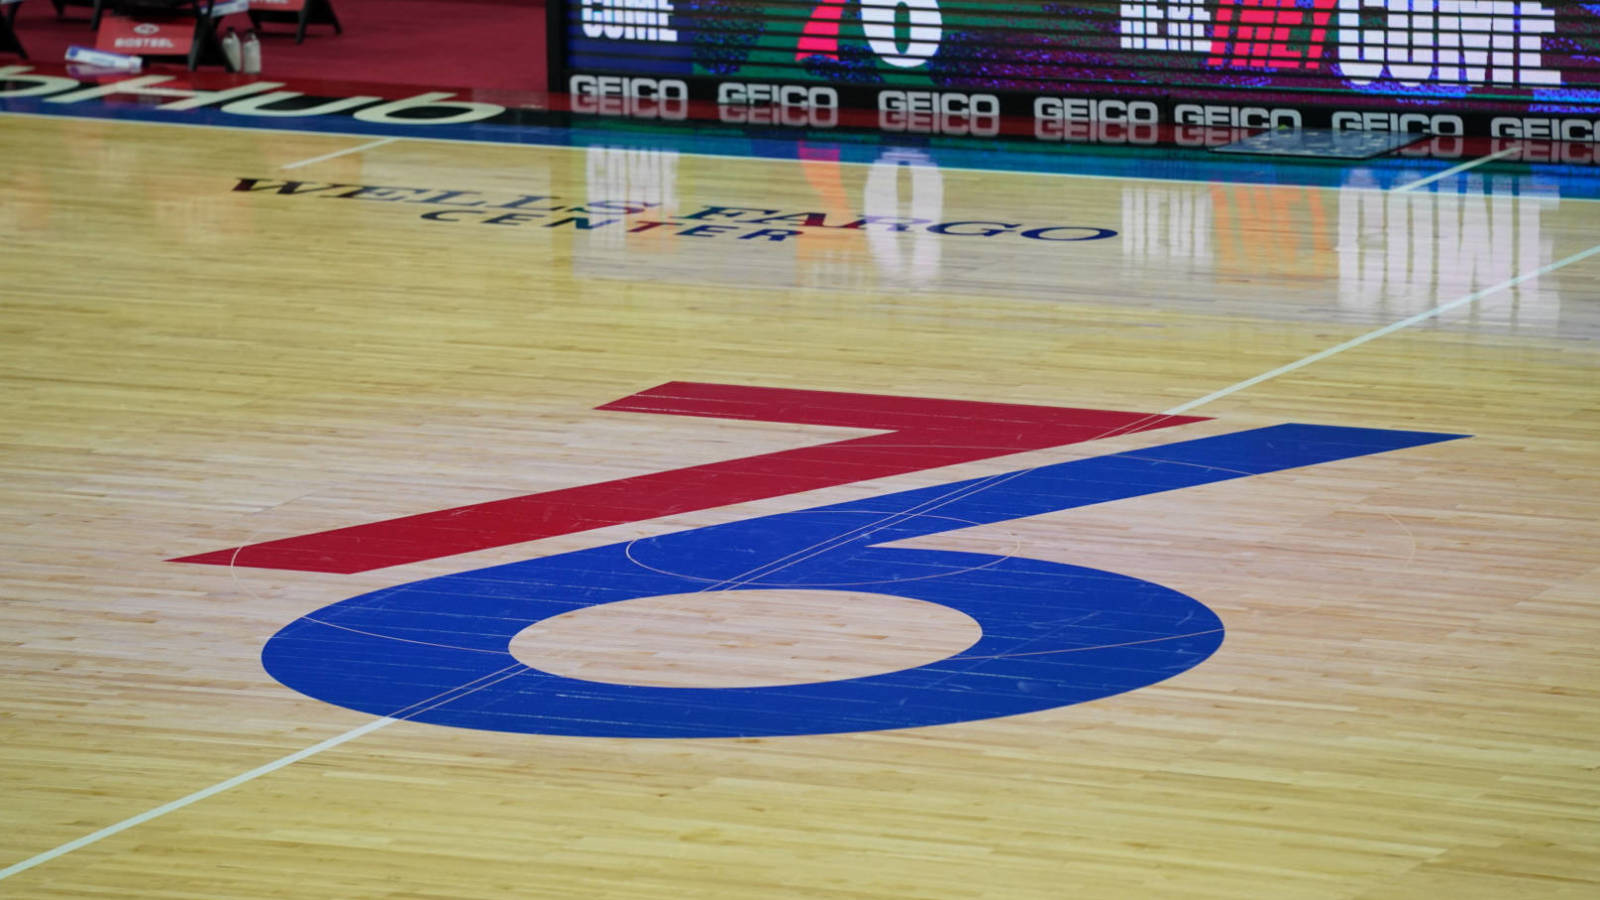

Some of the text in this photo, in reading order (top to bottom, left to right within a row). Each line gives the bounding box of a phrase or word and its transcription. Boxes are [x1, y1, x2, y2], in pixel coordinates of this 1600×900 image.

[569, 74, 688, 104] GEICO
[717, 82, 838, 107] GEICO
[878, 90, 1000, 116] GEICO
[1034, 97, 1159, 124] GEICO
[1175, 104, 1302, 129] GEICO
[1332, 111, 1464, 136] GEICO
[1491, 117, 1600, 142] GEIC
[231, 177, 663, 216] WELLS
[666, 205, 1119, 242] FARGO
[420, 209, 806, 243] CENTER
[165, 380, 1473, 739] 76
